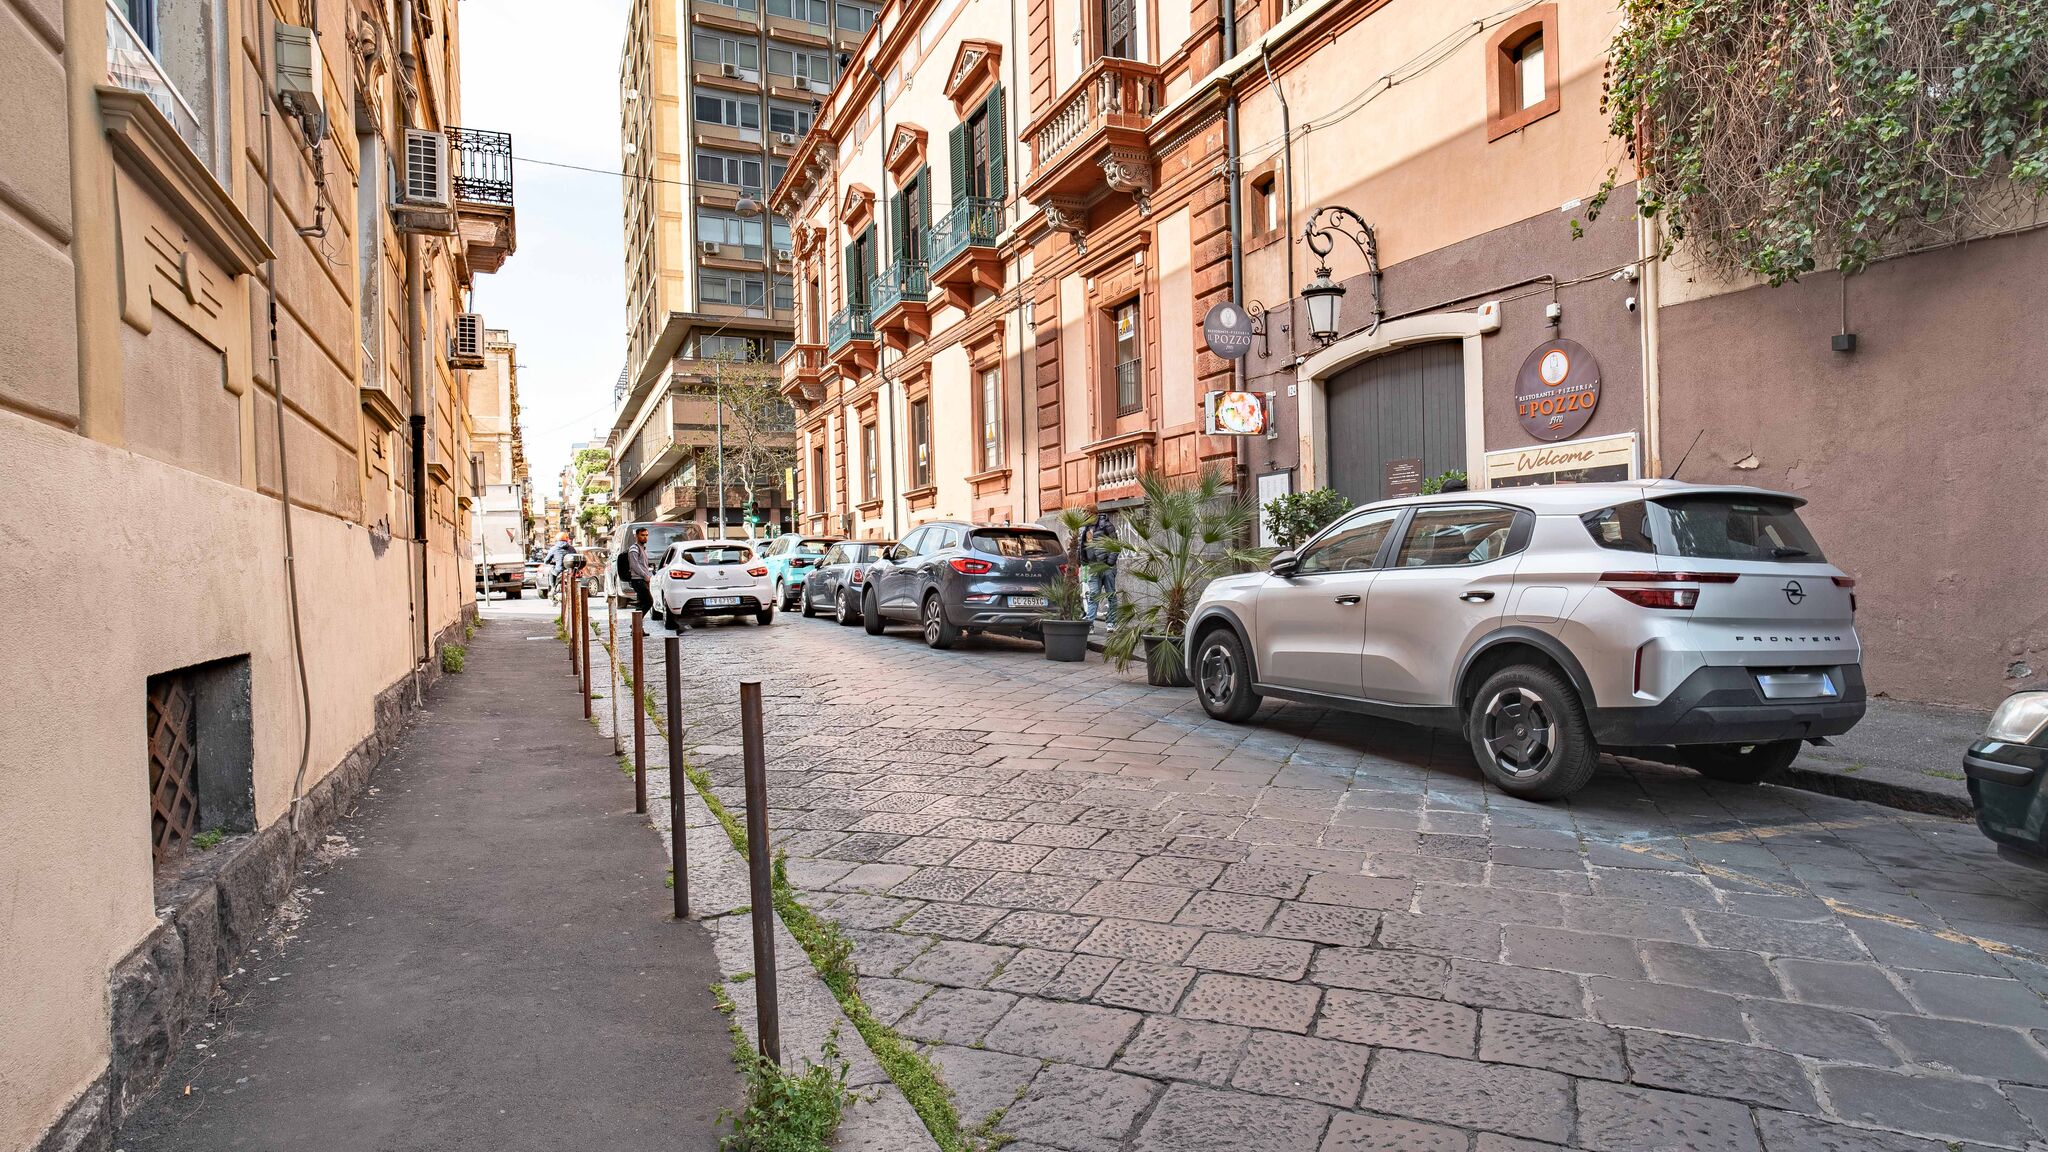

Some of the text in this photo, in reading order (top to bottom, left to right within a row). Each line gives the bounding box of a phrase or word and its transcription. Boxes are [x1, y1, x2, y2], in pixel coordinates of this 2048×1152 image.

[1214, 334, 1250, 345] POZZO
[1519, 383, 1593, 402] RISTORANTE PIZZERIA
[1520, 391, 1595, 418] IL POZZO
[1517, 448, 1595, 471] Welcome
